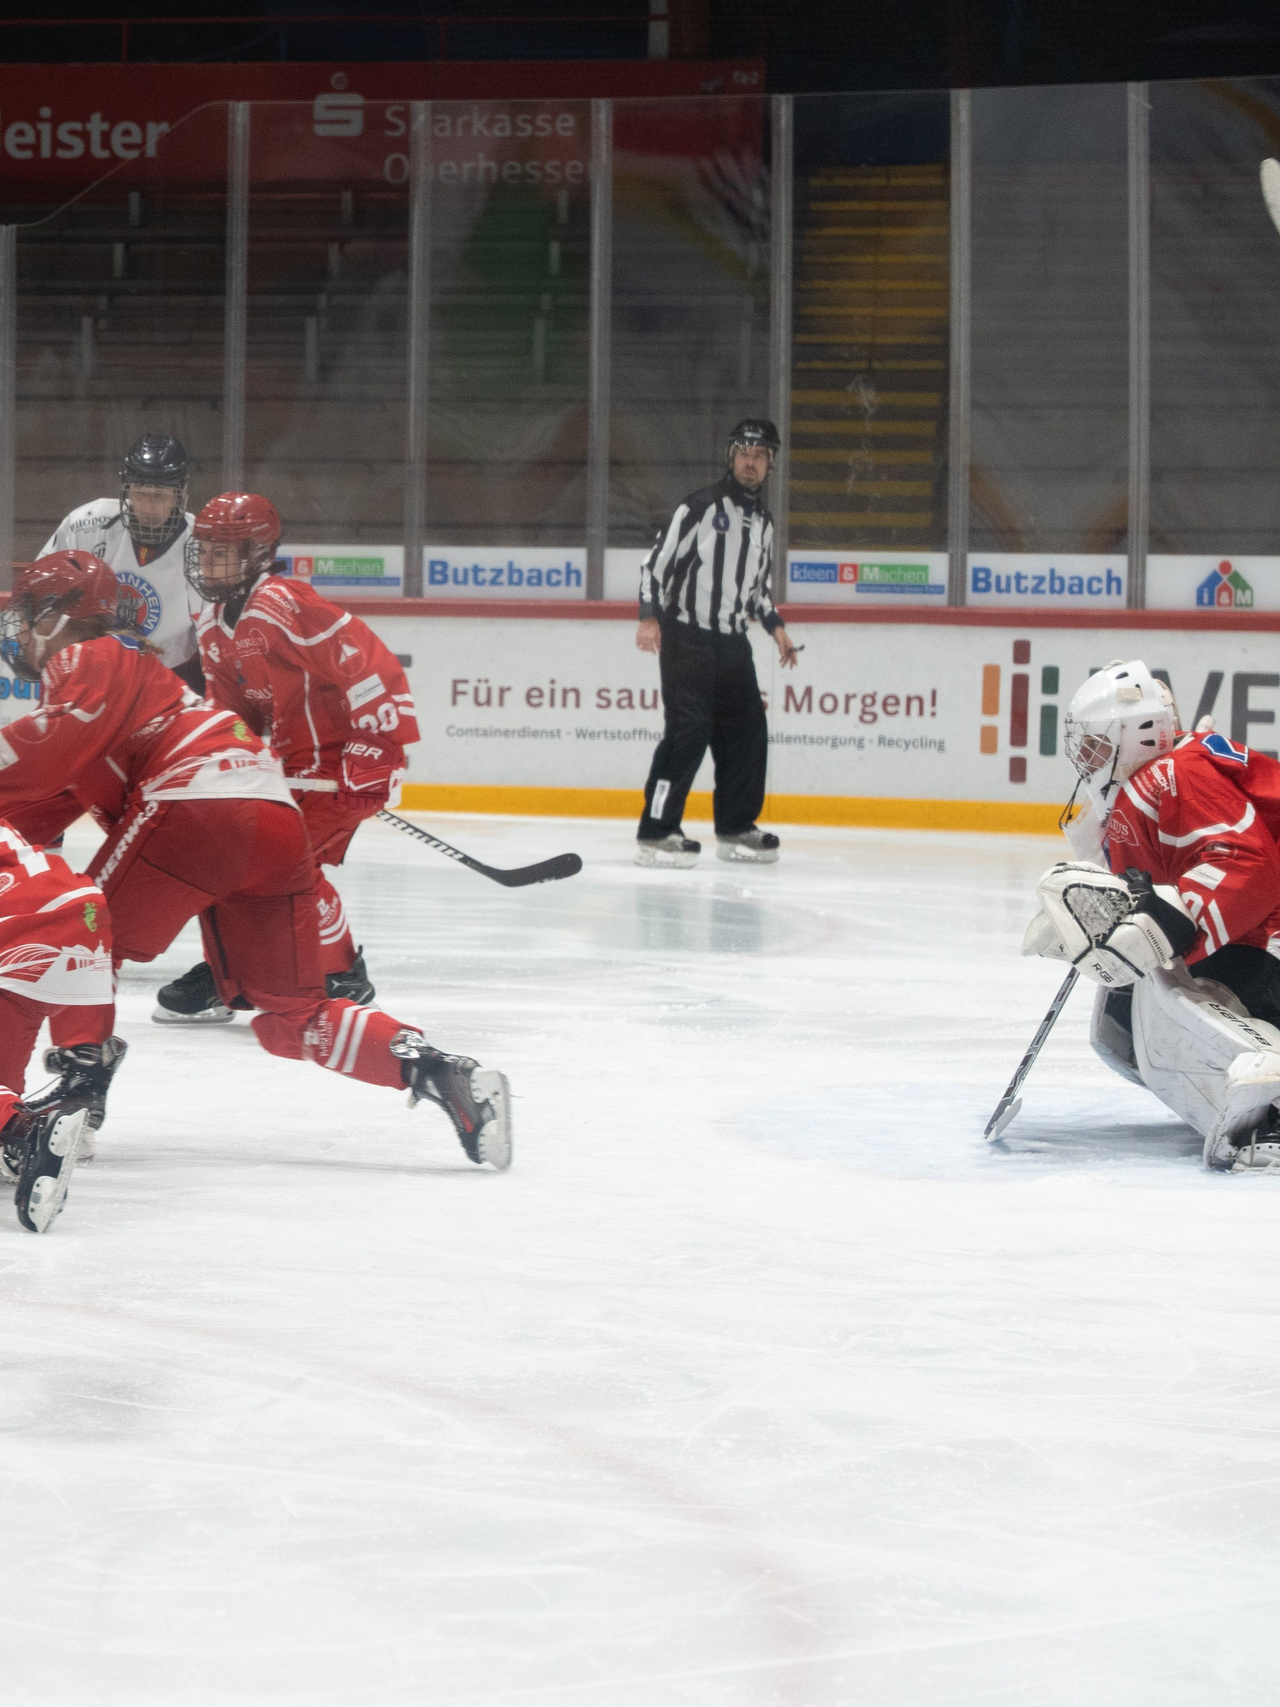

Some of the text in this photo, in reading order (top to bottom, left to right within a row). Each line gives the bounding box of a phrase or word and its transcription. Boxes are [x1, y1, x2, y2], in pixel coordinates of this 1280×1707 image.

[383, 152, 588, 185] Oerhesse
[428, 559, 583, 588] Butzbach
[971, 567, 1123, 596] Butzbach
[450, 679, 512, 709] Für
[524, 681, 582, 710] ein
[783, 684, 939, 724] Morgen!
[445, 724, 562, 741] Containerdienst
[767, 731, 865, 750] allentsorgung
[877, 733, 946, 752] Recycling
